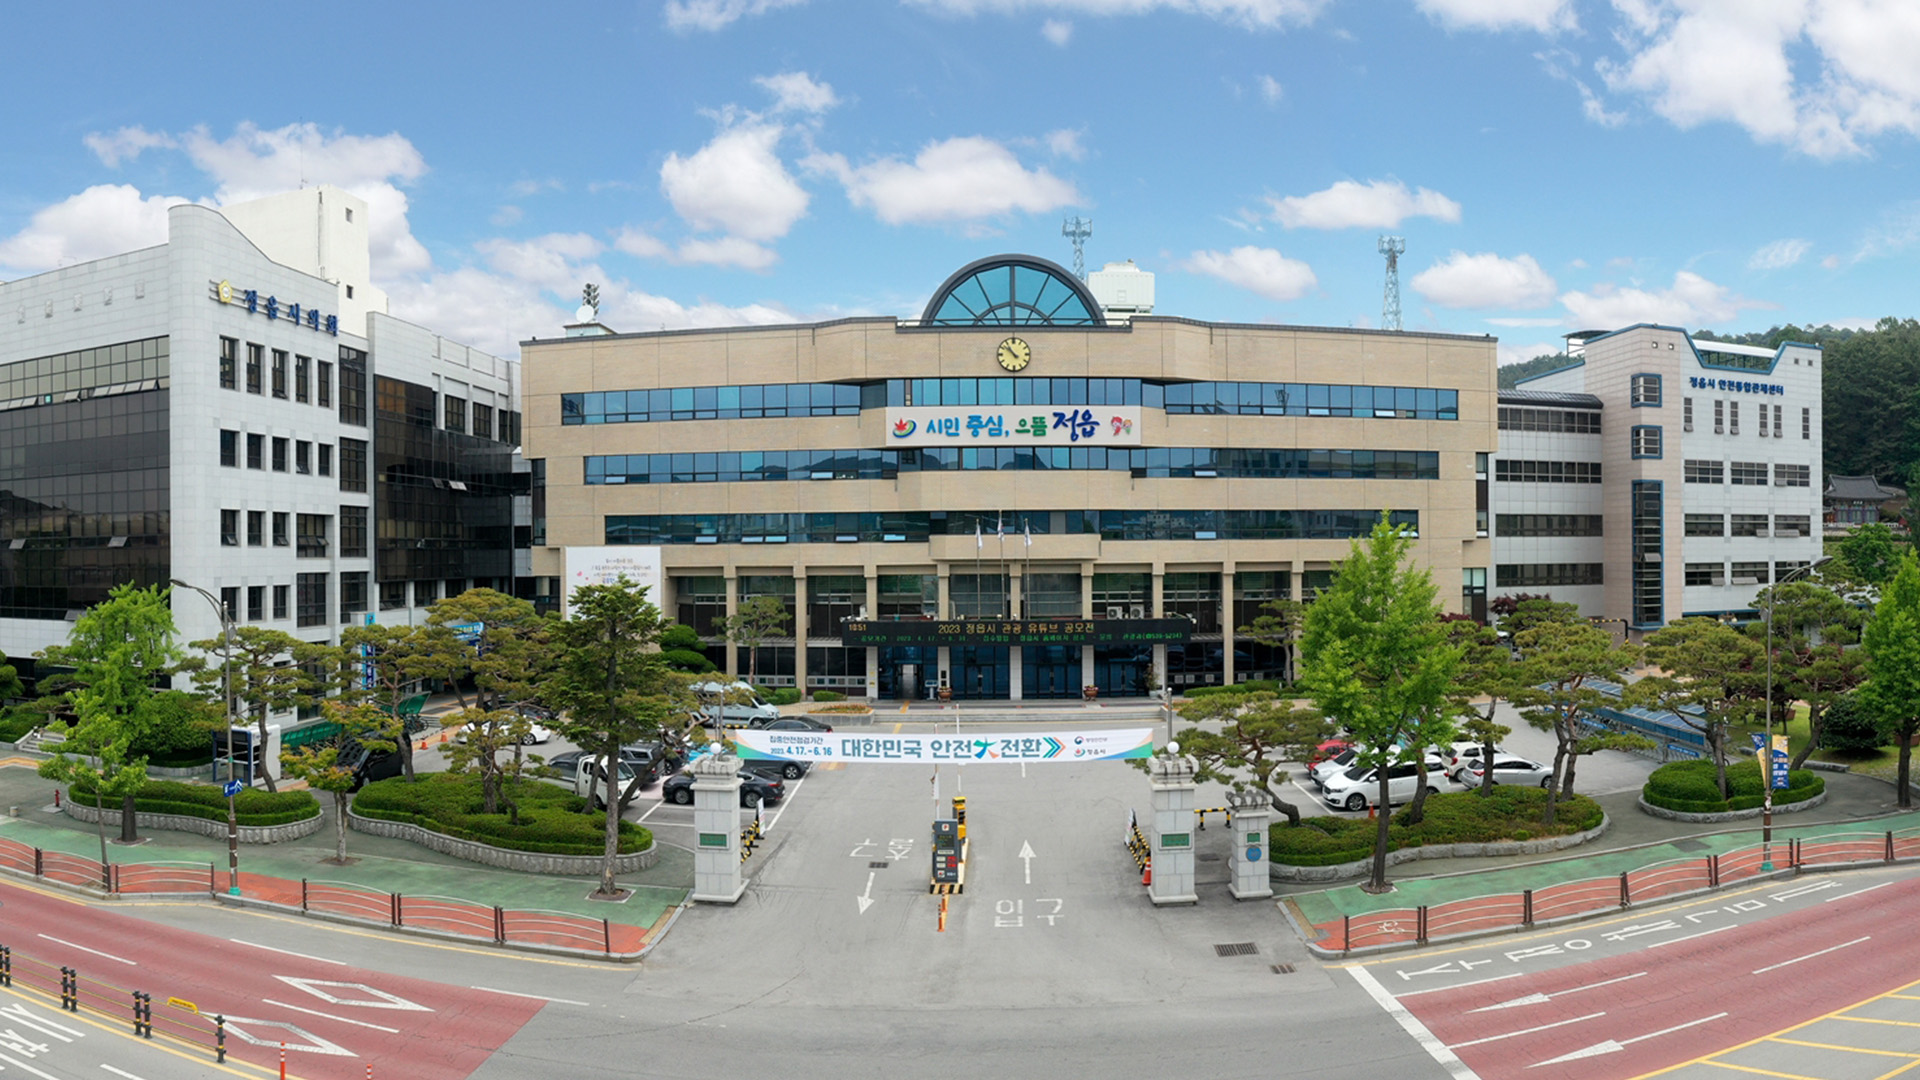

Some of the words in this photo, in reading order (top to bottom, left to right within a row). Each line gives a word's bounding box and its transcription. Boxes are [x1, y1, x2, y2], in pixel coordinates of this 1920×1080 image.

[244, 289, 338, 337] 정읍시의회
[1689, 376, 1716, 390] 정읍시
[926, 417, 960, 437] 시민
[966, 414, 1010, 438] 중심,
[1015, 416, 1048, 436] 으뜸
[1052, 409, 1100, 442] 정읍
[938, 624, 961, 634] 2023
[966, 623, 996, 634] 정읍시
[1002, 623, 1022, 634] 관광
[1028, 622, 1058, 633] 유튜브
[1064, 622, 1095, 633] 공모전
[822, 747, 833, 756] 16
[841, 739, 922, 758] 대한민국
[994, 898, 1064, 928] 입구
